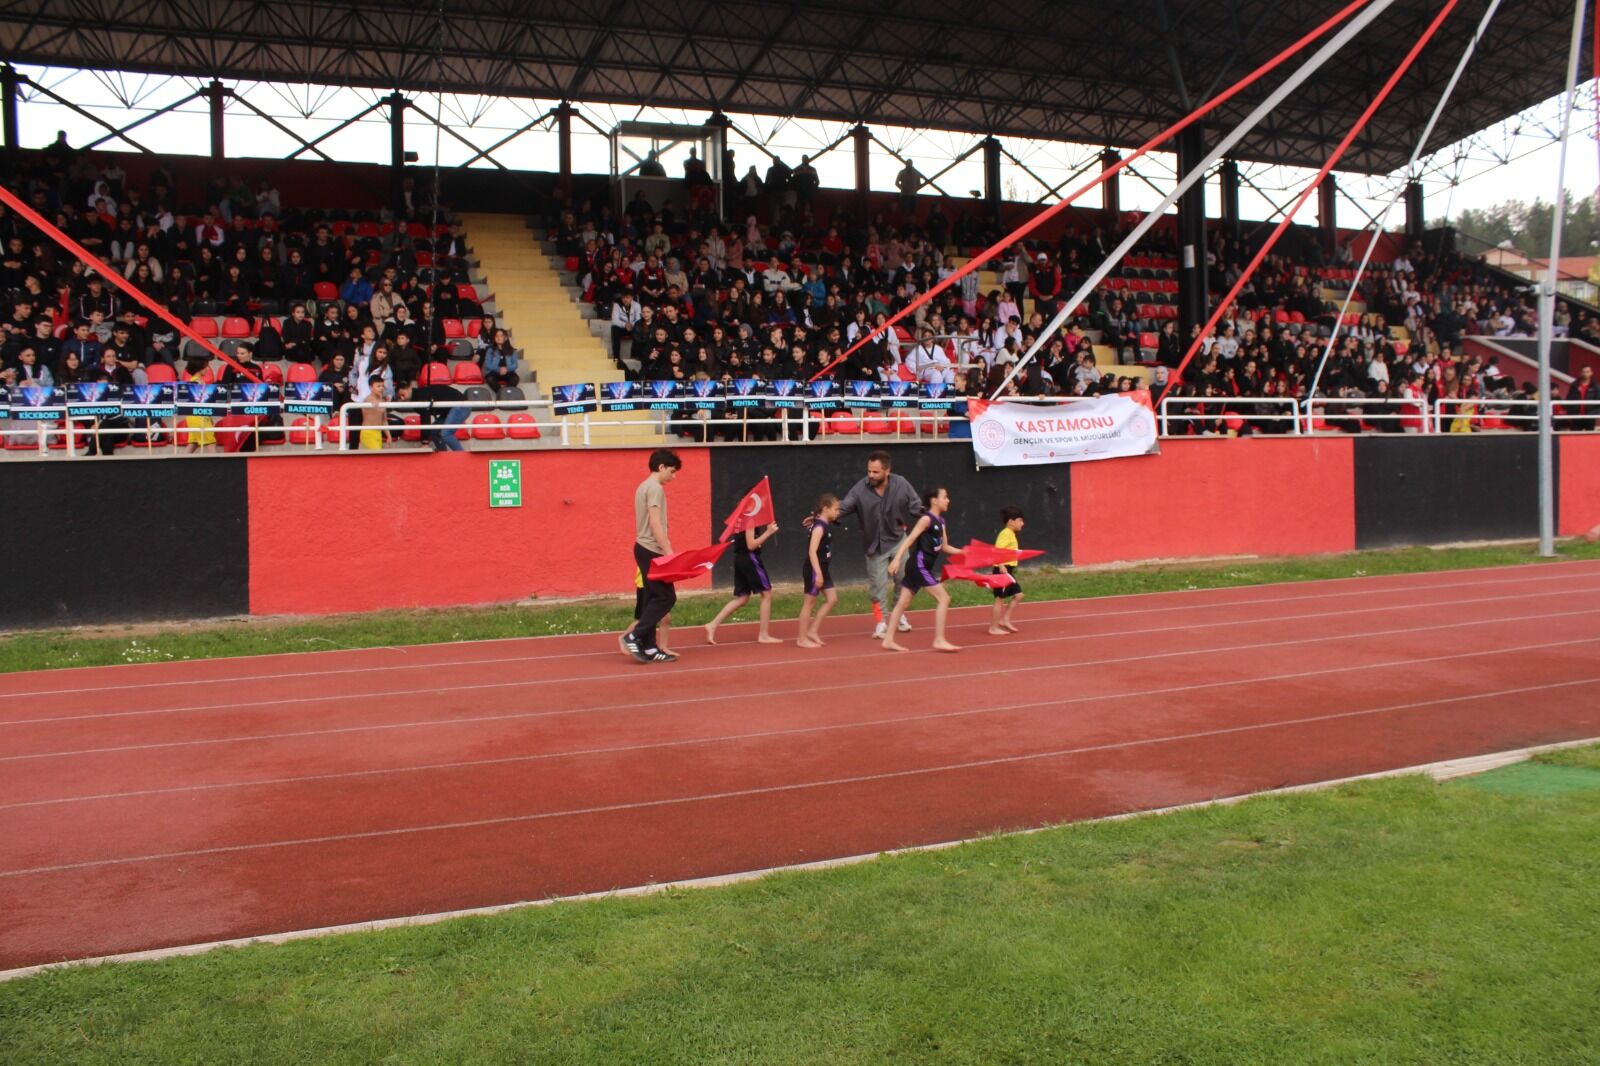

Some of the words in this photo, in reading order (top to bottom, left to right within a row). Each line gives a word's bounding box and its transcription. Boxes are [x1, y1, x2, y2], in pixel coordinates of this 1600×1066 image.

[69, 407, 119, 415] TAEKWONDO
[124, 409, 148, 417] MASA
[244, 406, 267, 415] GÜREŞ
[288, 405, 328, 414] BASKETBOL
[1015, 416, 1115, 433] KASTAMONU
[1013, 437, 1044, 446] GENÇLİK
